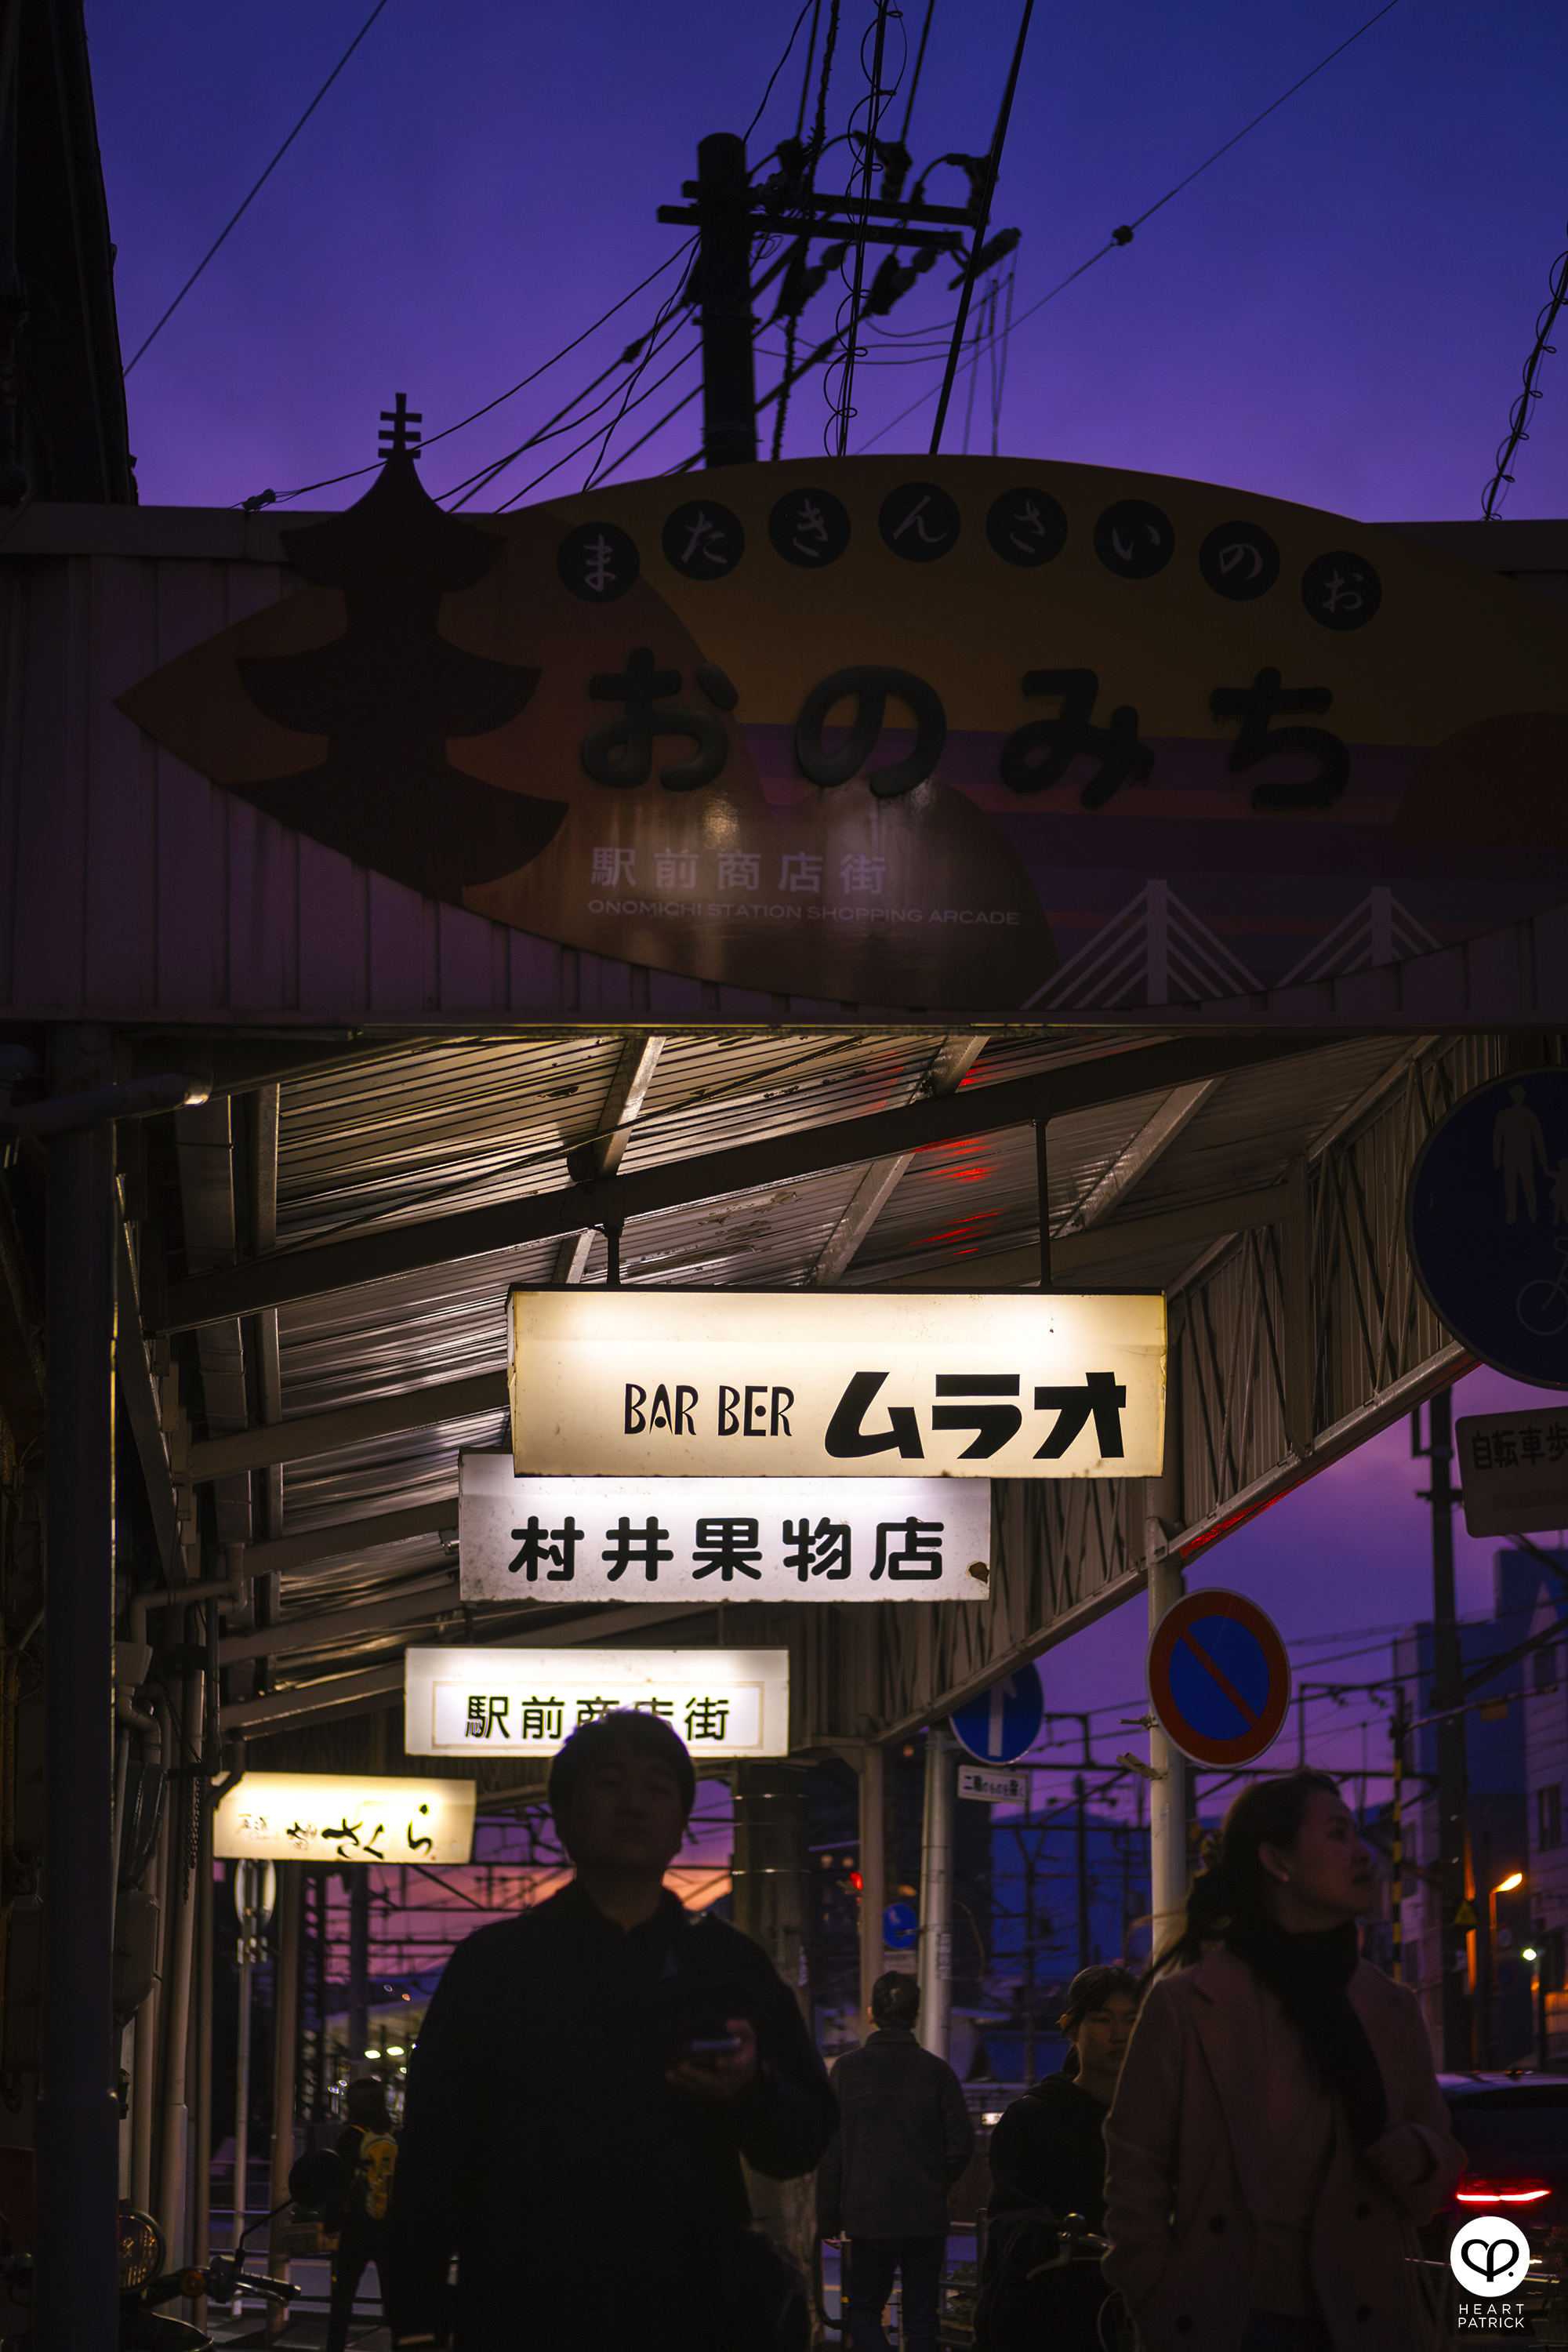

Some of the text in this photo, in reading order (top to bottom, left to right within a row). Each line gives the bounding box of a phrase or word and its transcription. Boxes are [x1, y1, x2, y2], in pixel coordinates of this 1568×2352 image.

[581, 647, 1352, 811] おのみち
[590, 847, 887, 895] 駅前商店街
[587, 898, 1021, 926] ONOMICHI STATION SHOPPING ARCADE
[624, 1371, 1127, 1460] BAR BER ムラオ
[508, 1515, 945, 1582] 村井果物店
